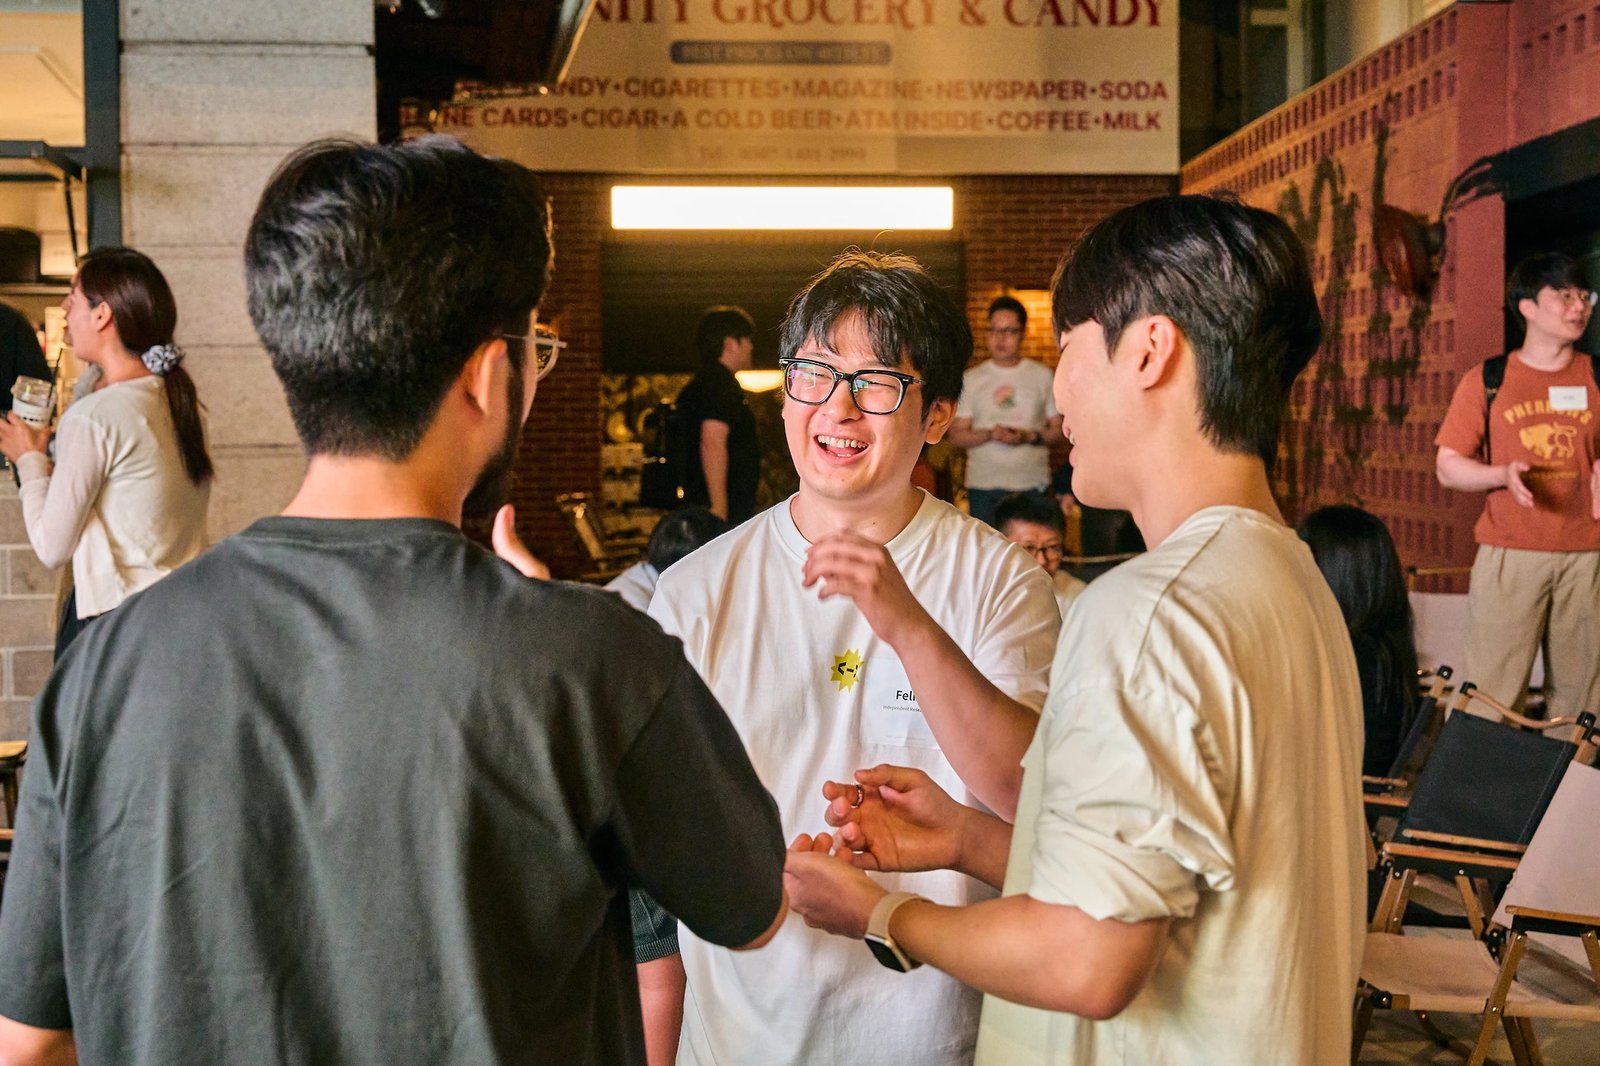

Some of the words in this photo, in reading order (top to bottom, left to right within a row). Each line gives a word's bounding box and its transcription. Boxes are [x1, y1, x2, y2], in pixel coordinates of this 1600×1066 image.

[711, 0, 936, 30] GROCERY
[959, 0, 987, 27] &
[1002, 0, 1167, 27] CANDY
[624, 76, 780, 98] CIGARETTES
[792, 78, 922, 100] MAGAZINE
[935, 79, 1087, 101] NEWSPAPER
[1100, 80, 1169, 101] SODA
[481, 106, 568, 128] CARDS
[580, 107, 659, 129] CIGAR
[695, 108, 764, 129] COLD
[771, 109, 832, 130] BEER
[846, 110, 899, 130] ATM
[904, 110, 983, 131] INSIDE
[997, 110, 1090, 132] COFFEE
[1103, 110, 1162, 131] MILK
